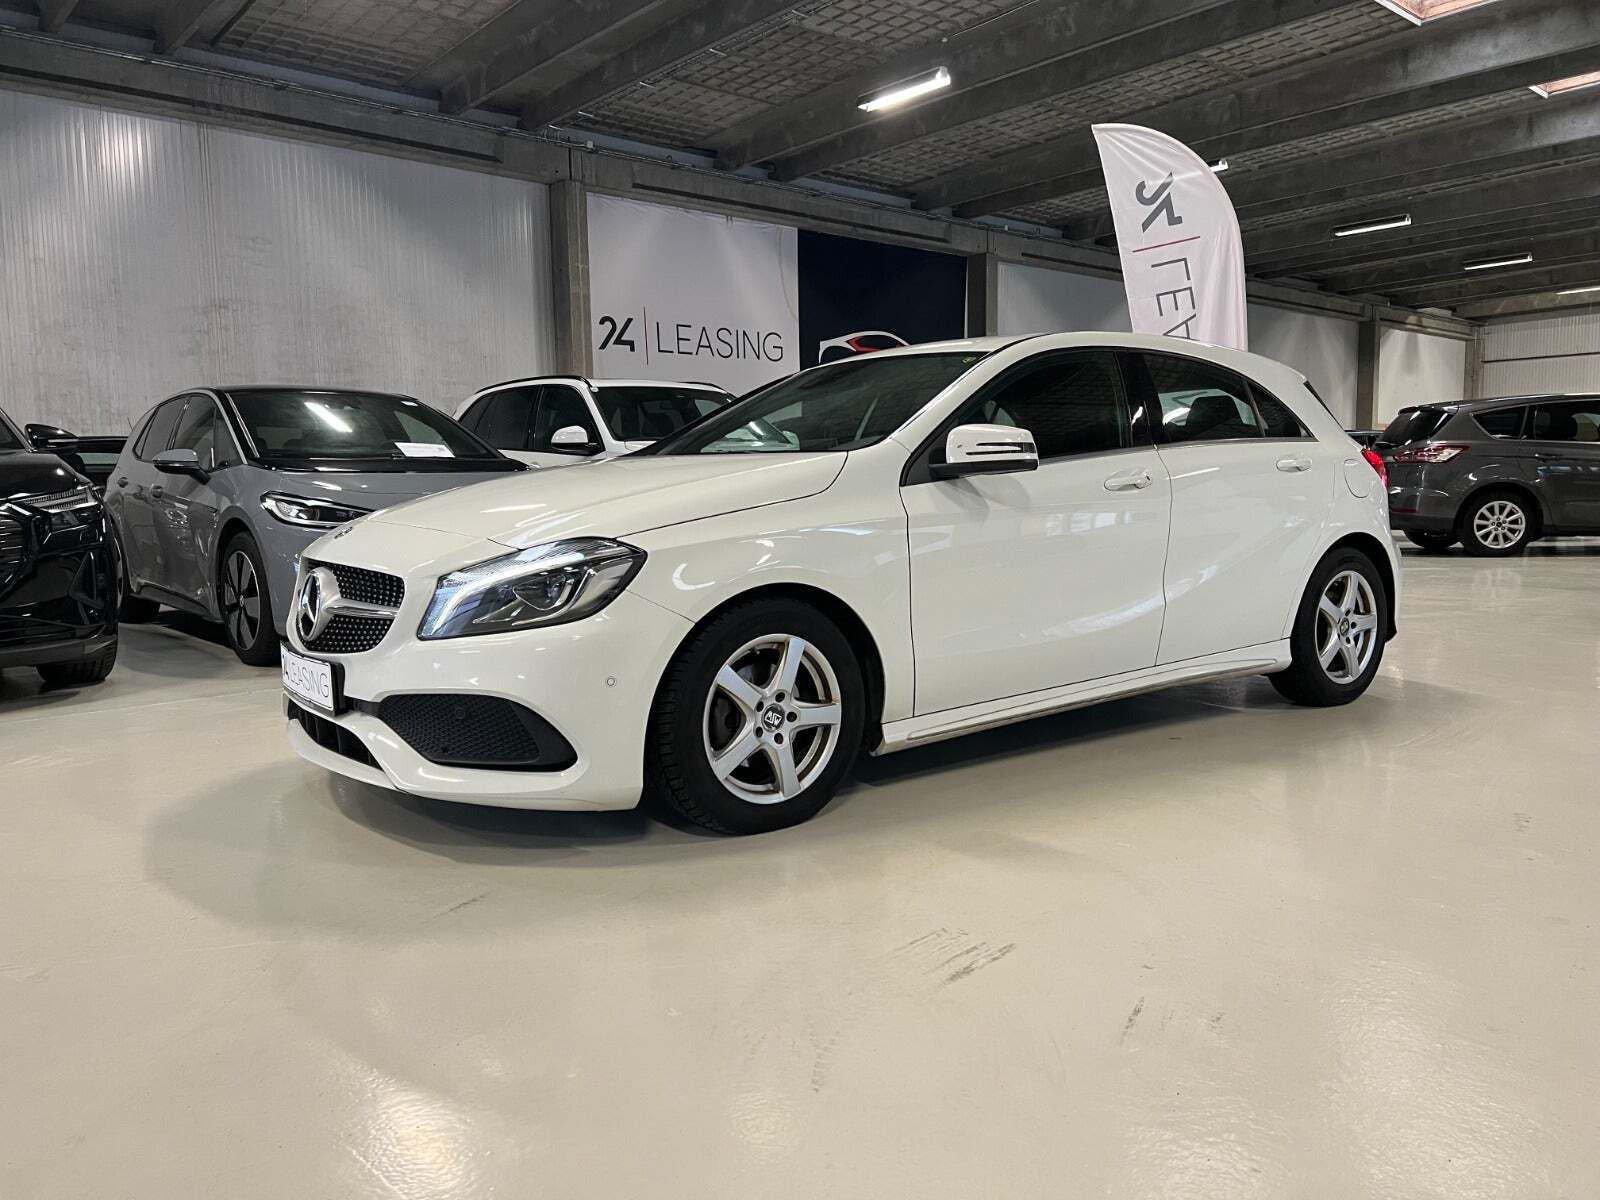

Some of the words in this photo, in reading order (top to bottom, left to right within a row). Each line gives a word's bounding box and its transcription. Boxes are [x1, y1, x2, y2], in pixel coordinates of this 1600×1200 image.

[598, 315, 636, 353] 24
[656, 321, 784, 362] LEASING
[290, 659, 330, 698] LEASING
